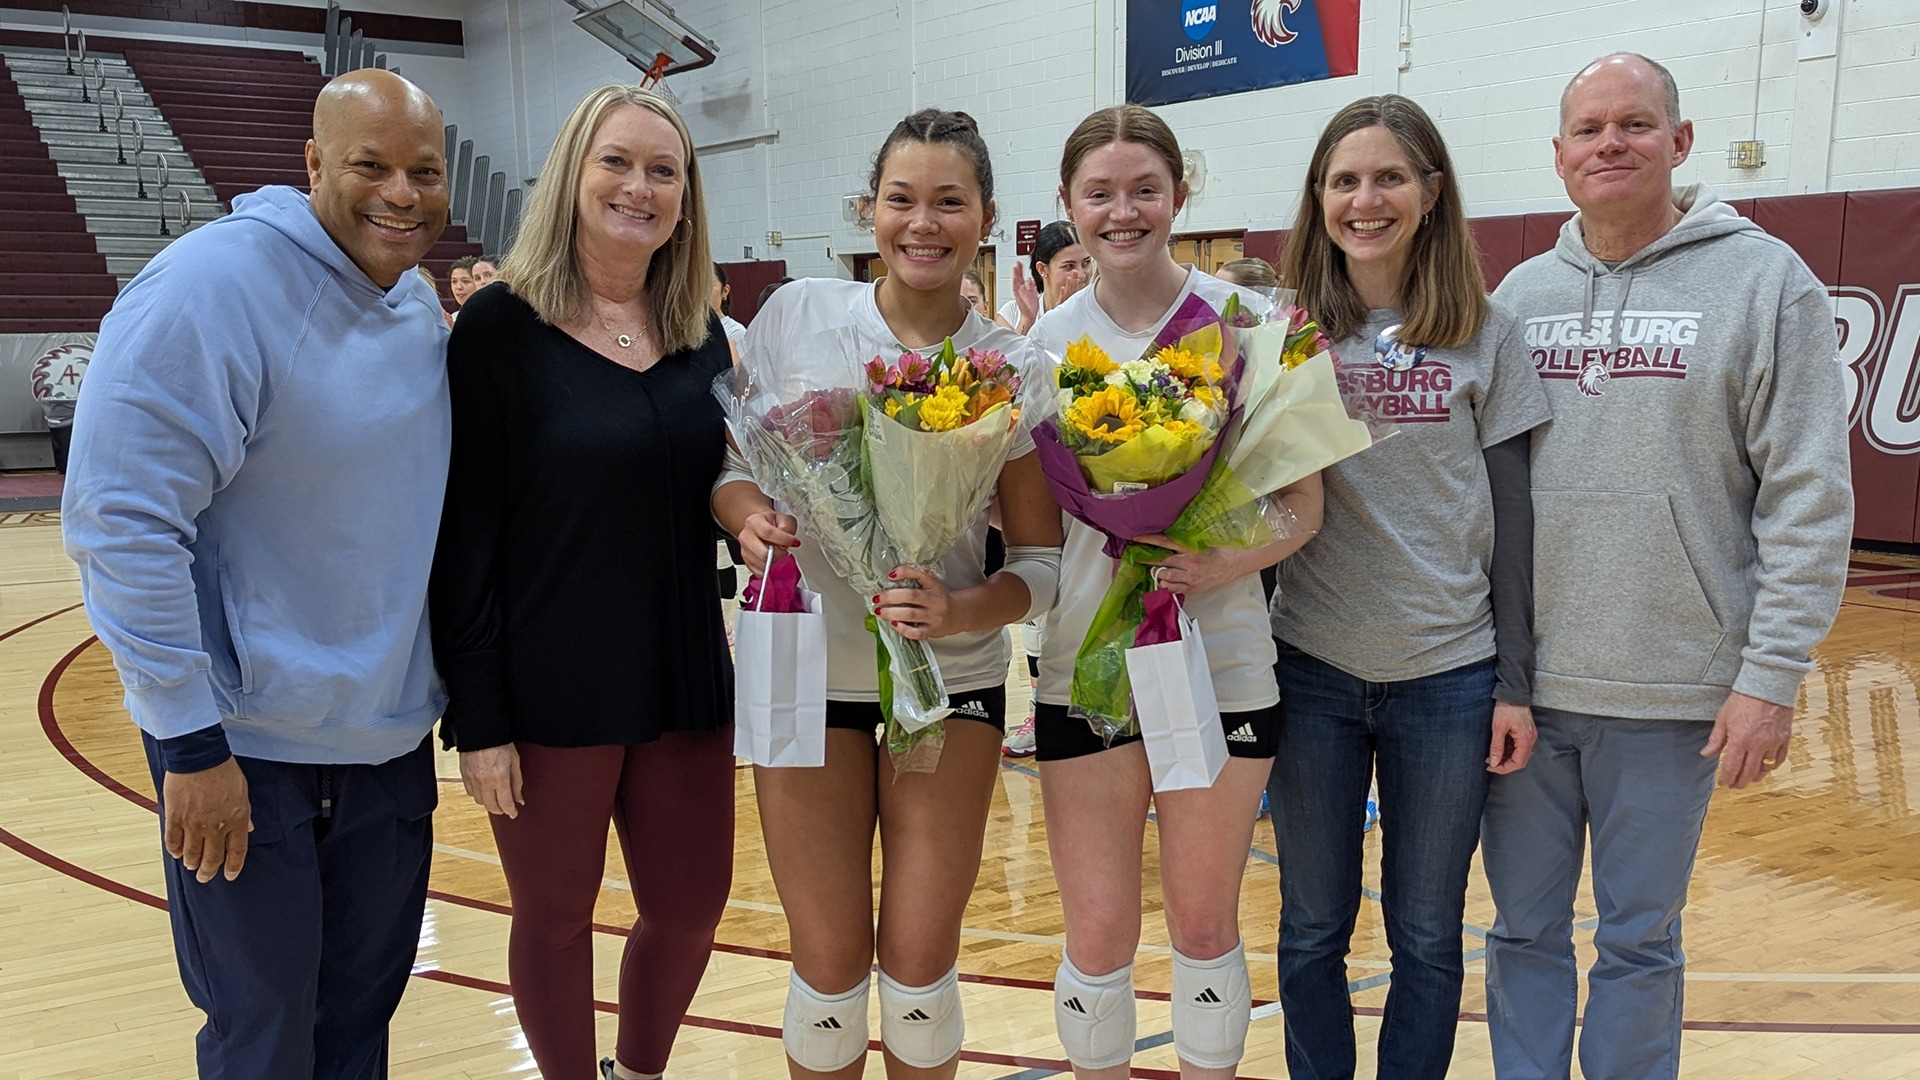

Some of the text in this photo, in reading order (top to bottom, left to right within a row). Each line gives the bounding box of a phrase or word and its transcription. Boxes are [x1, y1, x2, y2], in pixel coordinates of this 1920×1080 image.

[1185, 5, 1216, 27] NCAA
[1175, 40, 1223, 63] Division III
[1161, 57, 1238, 76] DISCOVER DEVELOP DEDICATE
[1531, 346, 1688, 371] OLLEYBALL
[956, 708, 989, 718] adidas
[1226, 734, 1257, 742] adidas
